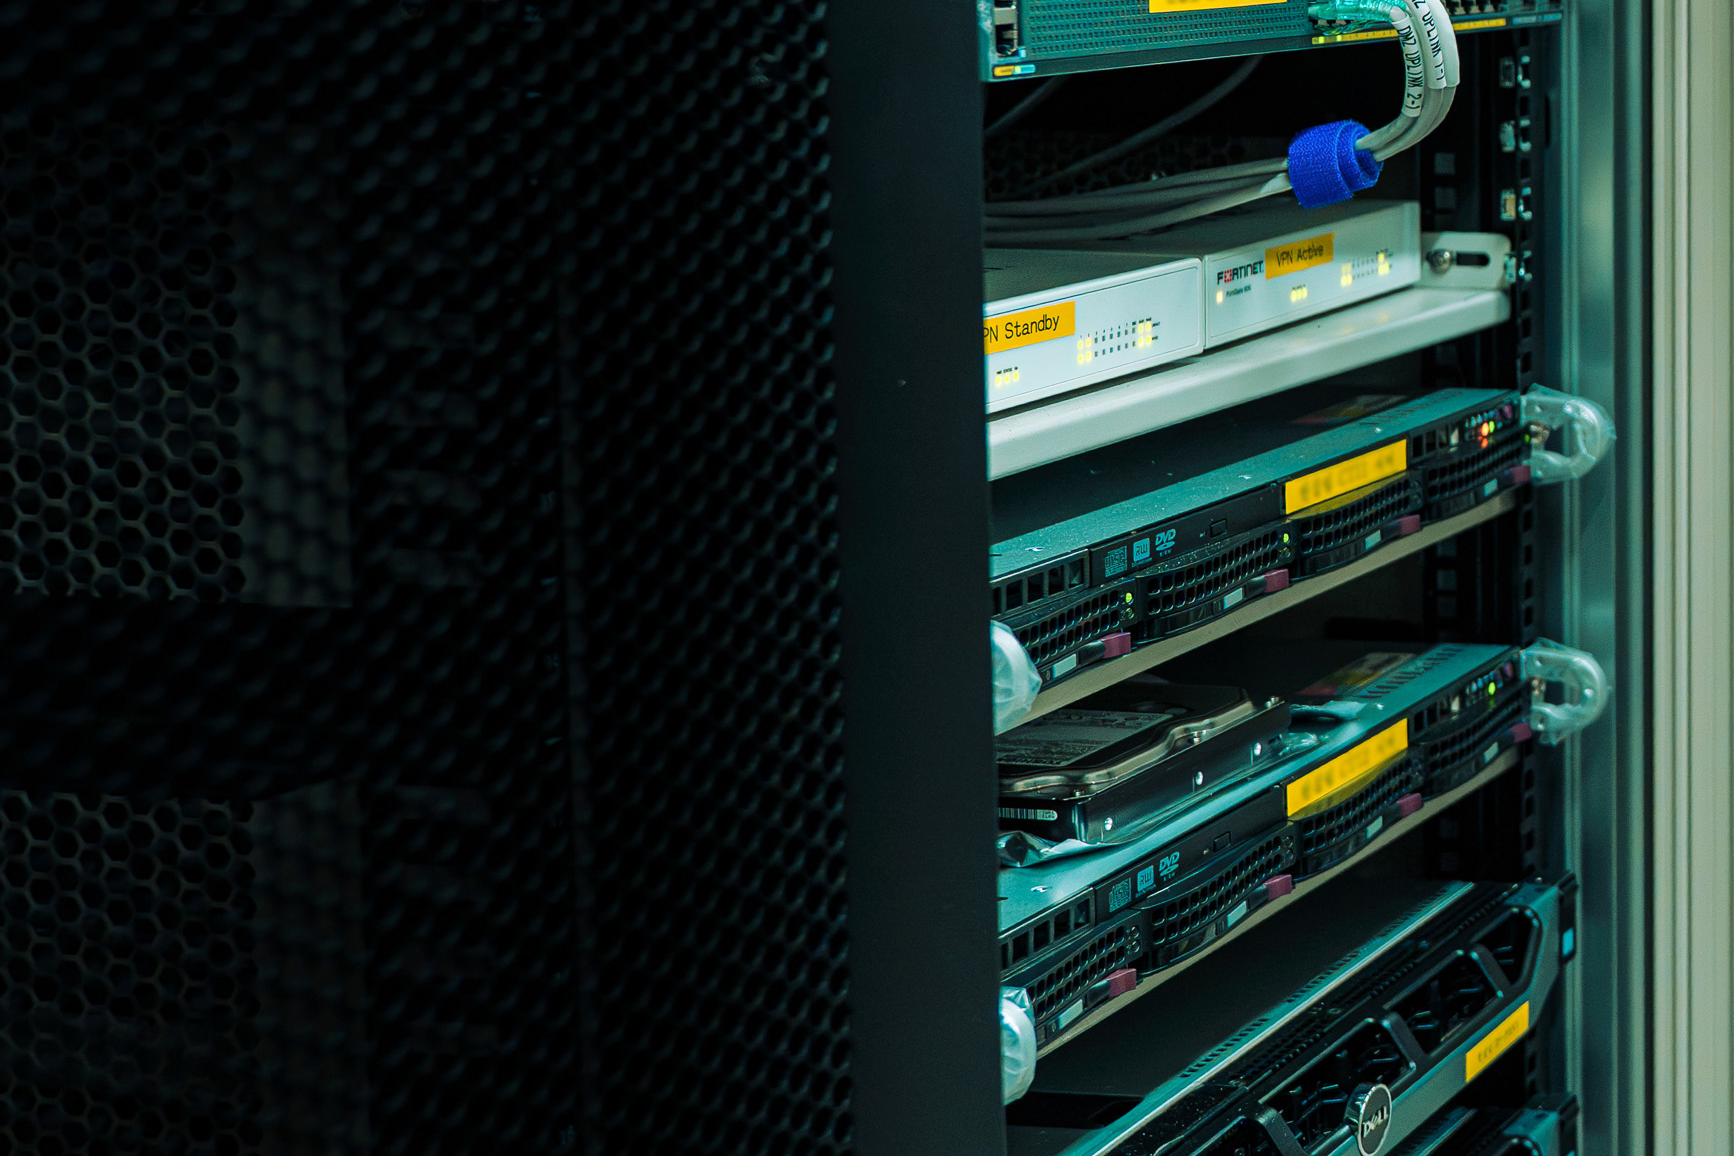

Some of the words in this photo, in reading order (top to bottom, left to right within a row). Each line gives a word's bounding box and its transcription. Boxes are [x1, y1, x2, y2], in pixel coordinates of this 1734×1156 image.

[1397, 25, 1417, 47] DMZ
[1422, 11, 1442, 58] UPLINK
[1405, 51, 1424, 88] UPLINK
[1405, 92, 1422, 110] 2-1
[1276, 249, 1294, 267] VPN
[1297, 243, 1324, 262] Active
[1217, 260, 1264, 285] FORTINET
[984, 326, 999, 344] PN
[1005, 314, 1060, 340] Standby
[1155, 528, 1177, 546] DVD
[1159, 851, 1180, 872] DVD
[1363, 1105, 1388, 1138] DELL
